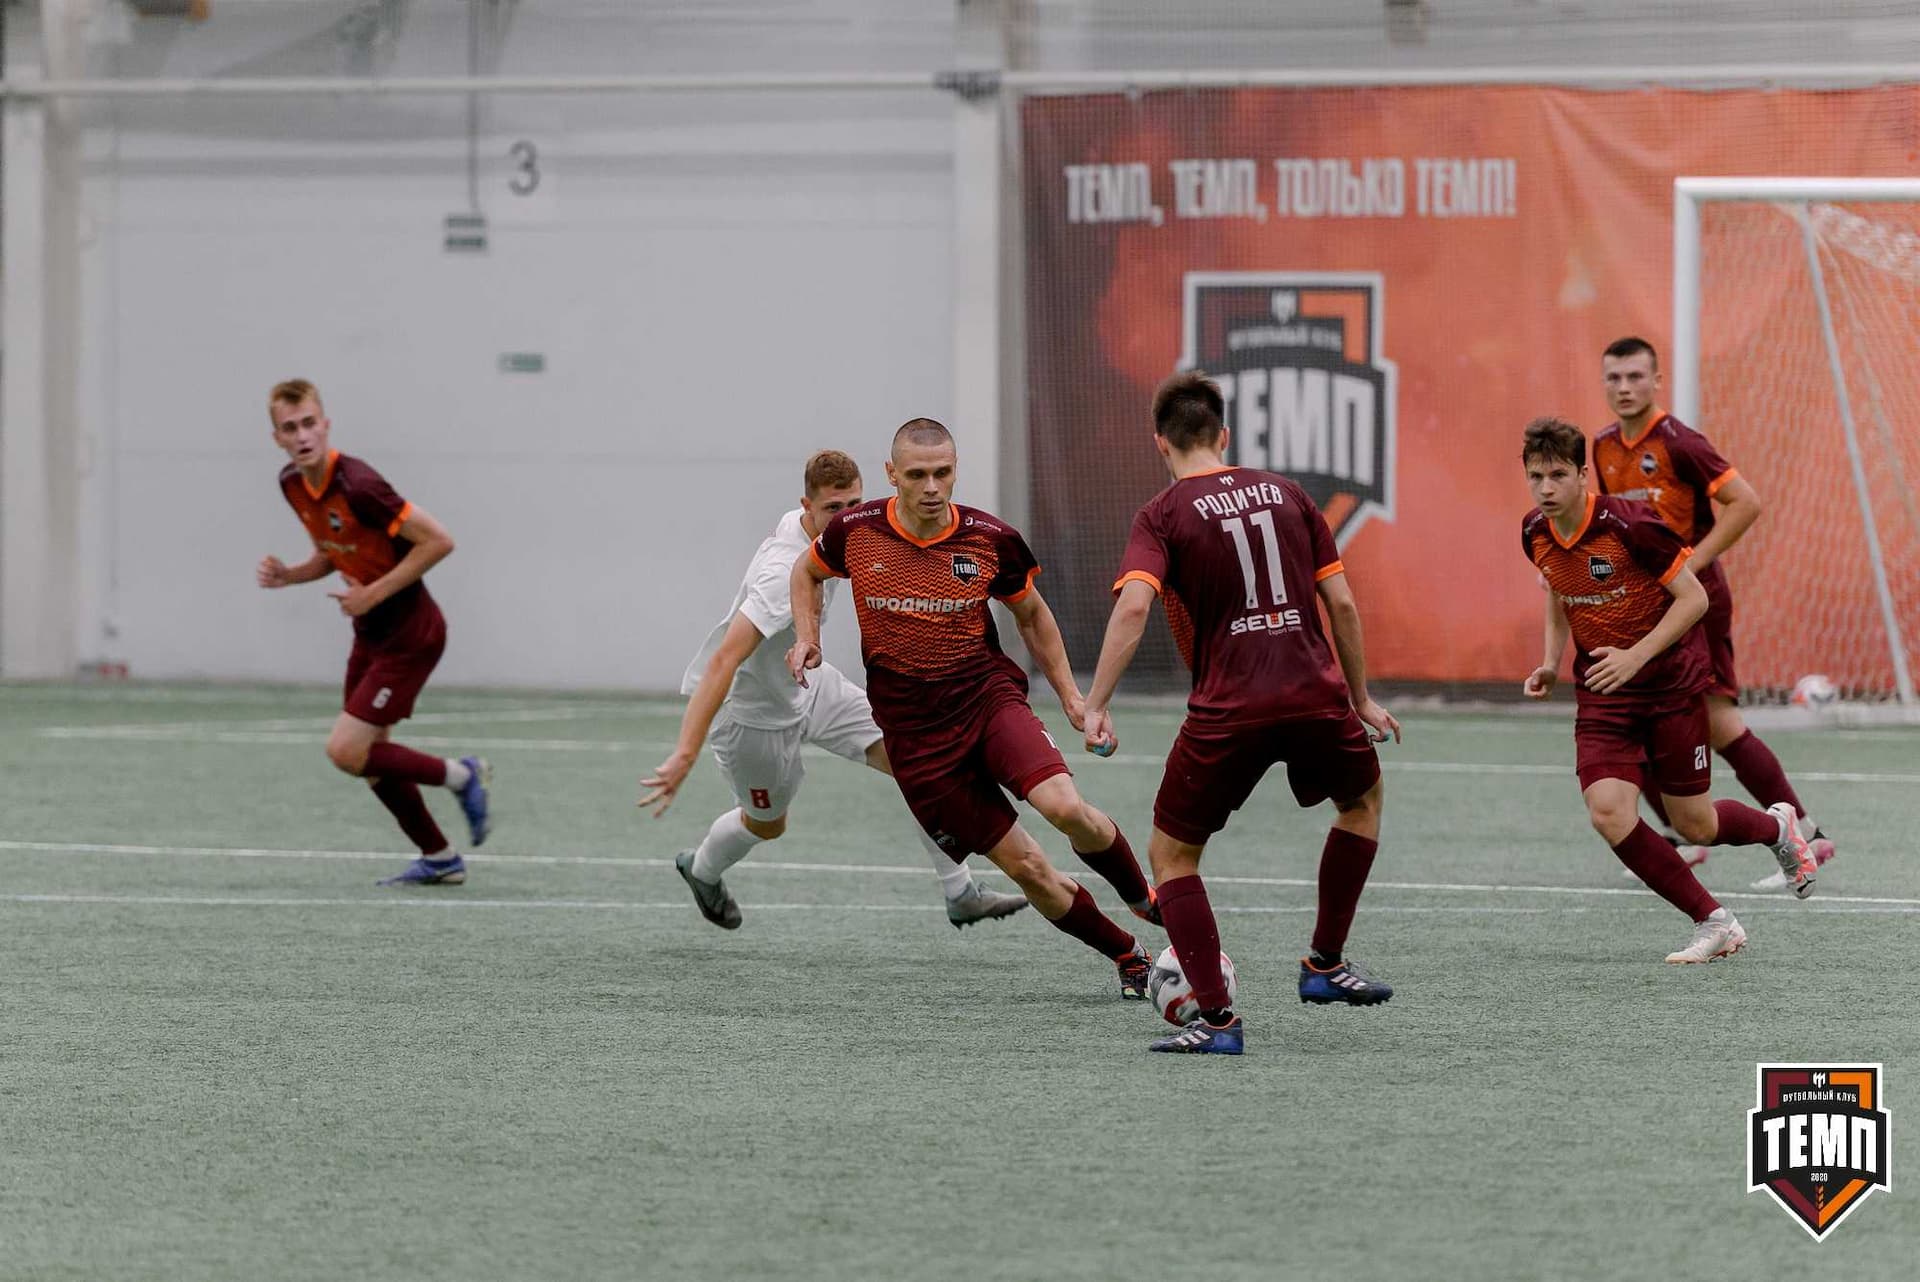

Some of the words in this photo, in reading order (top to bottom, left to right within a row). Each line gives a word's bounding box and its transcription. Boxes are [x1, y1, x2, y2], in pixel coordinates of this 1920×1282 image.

[509, 140, 541, 195] 3
[1064, 163, 1164, 227] ТЕМП,
[1169, 159, 1268, 224] ТЕМП,
[1274, 158, 1405, 218] ТОЛЬКО
[1414, 158, 1517, 217] ТЕМП!
[1193, 483, 1284, 520] РОДИЧЕВ
[954, 563, 977, 575] ТЕМП
[1221, 509, 1288, 610] 11
[1230, 609, 1301, 635] SEUS
[372, 687, 393, 709] 6
[1694, 744, 1708, 770] 21
